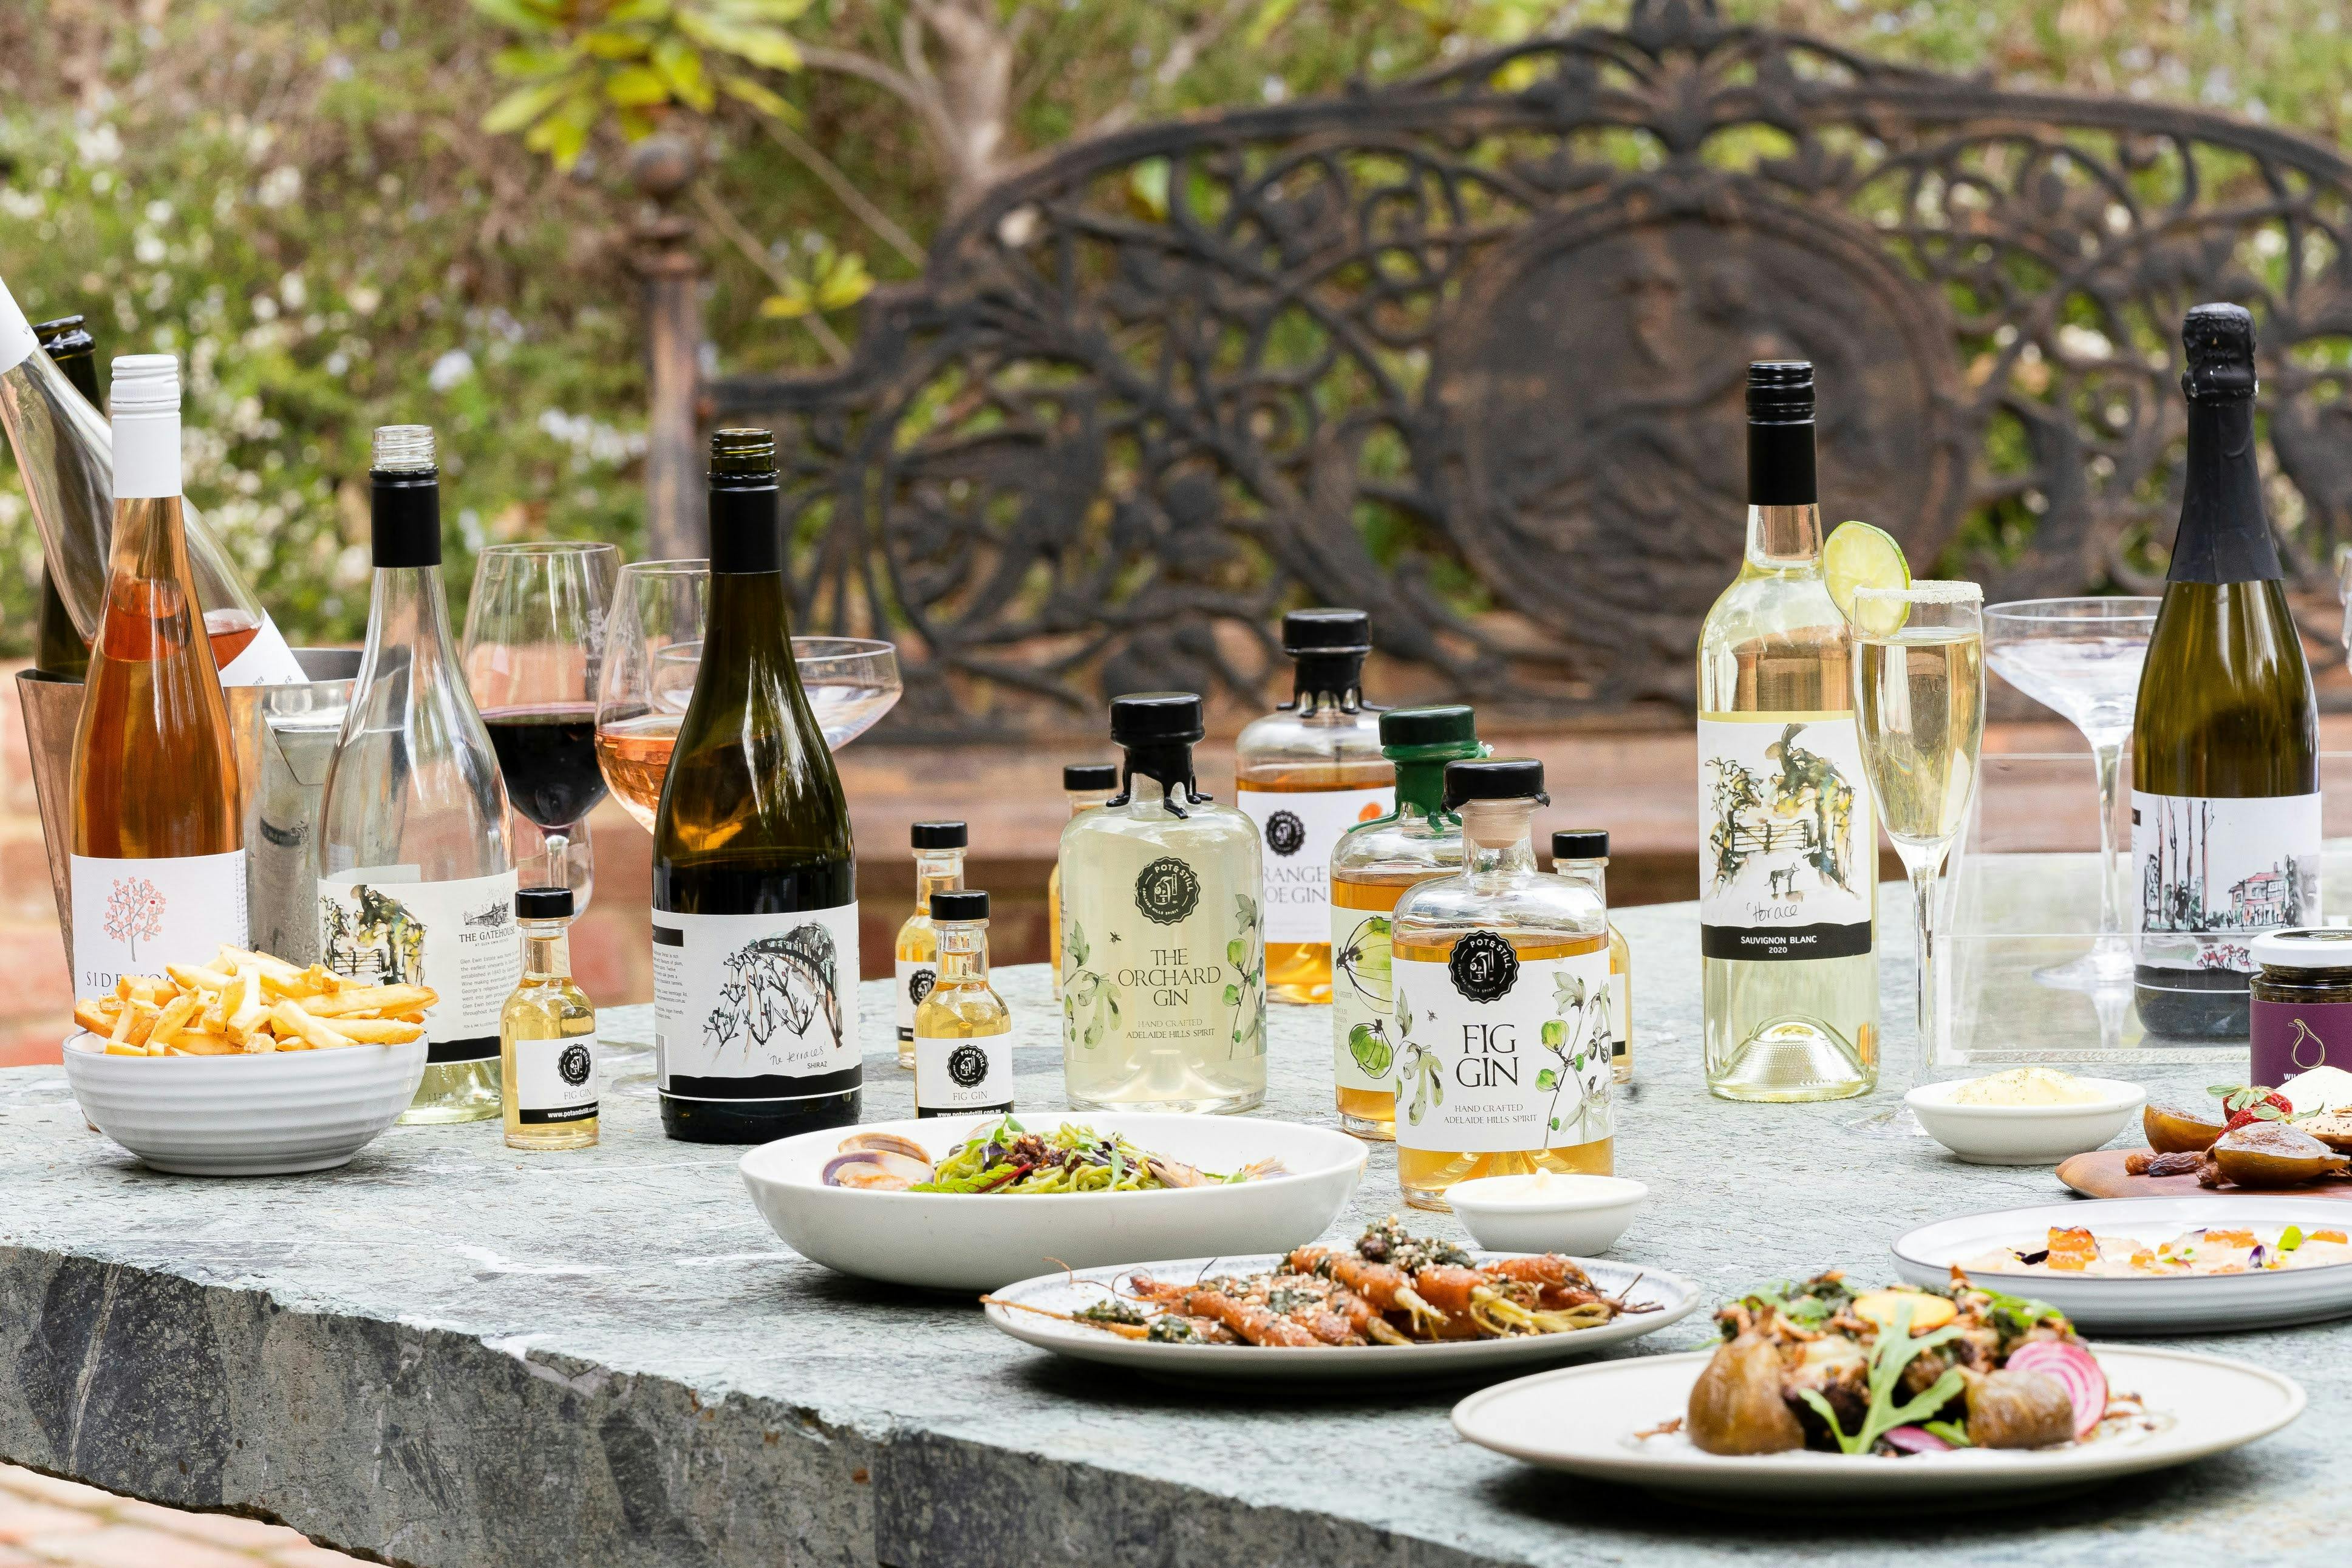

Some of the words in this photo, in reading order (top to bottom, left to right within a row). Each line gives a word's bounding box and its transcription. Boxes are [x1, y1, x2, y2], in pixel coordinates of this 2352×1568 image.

[1179, 869, 1193, 892] STILL
[1263, 866, 1327, 882] RANGE
[1264, 886, 1288, 904] OE
[1292, 886, 1326, 904] GIN
[458, 933, 477, 943] THE
[479, 925, 515, 941] GATEHOUSE
[1740, 936, 1787, 944] SAUVIGNON
[1790, 935, 1817, 944] BLANC
[1150, 948, 1188, 966] THE
[1496, 944, 1512, 969] STILL
[1118, 966, 1221, 986] ORCHARD
[1153, 989, 1188, 1006] GIN
[1165, 1018, 1203, 1027] CRAFTED
[1193, 1028, 1215, 1037] SPIRIT
[1462, 1024, 1516, 1054] FIG
[976, 1052, 985, 1068] STILL
[1456, 1057, 1519, 1087] GIN
[564, 1091, 577, 1100] FIG
[580, 1088, 591, 1098] GIN
[971, 1091, 987, 1100] GIN
[1483, 1103, 1523, 1112] CRAFTED
[1513, 1114, 1538, 1123] SPIRIT
